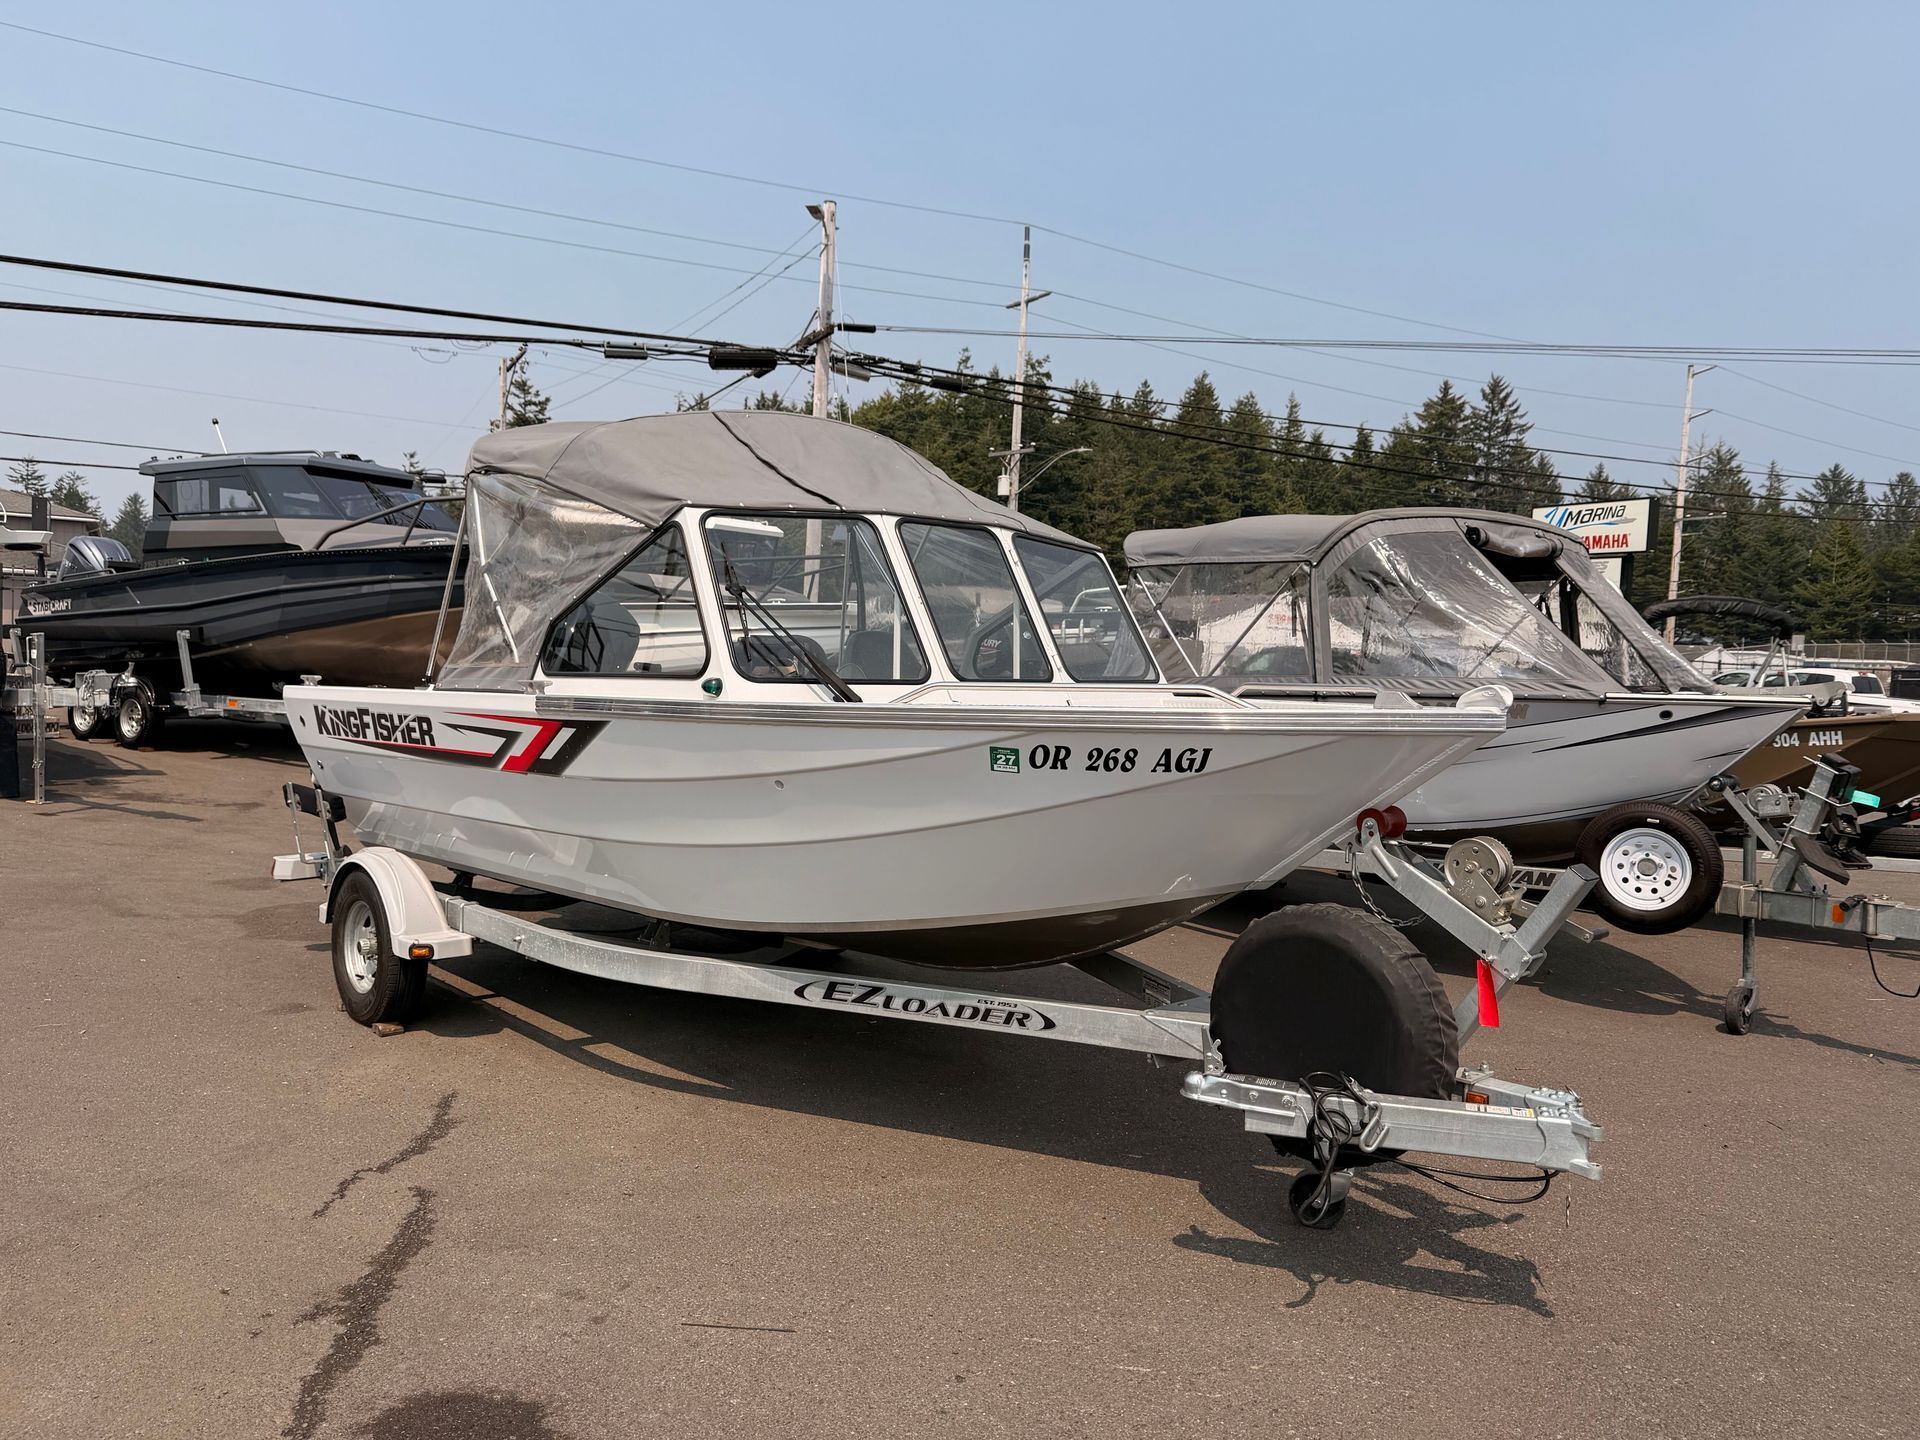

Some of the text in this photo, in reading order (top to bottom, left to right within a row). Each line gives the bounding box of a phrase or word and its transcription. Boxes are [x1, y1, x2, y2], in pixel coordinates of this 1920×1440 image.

[1582, 533, 1629, 550] AMAHA
[1773, 731, 1843, 748] 304 AHH
[996, 754, 1016, 766] 27
[1028, 744, 1213, 773] OR 268 AGJ
